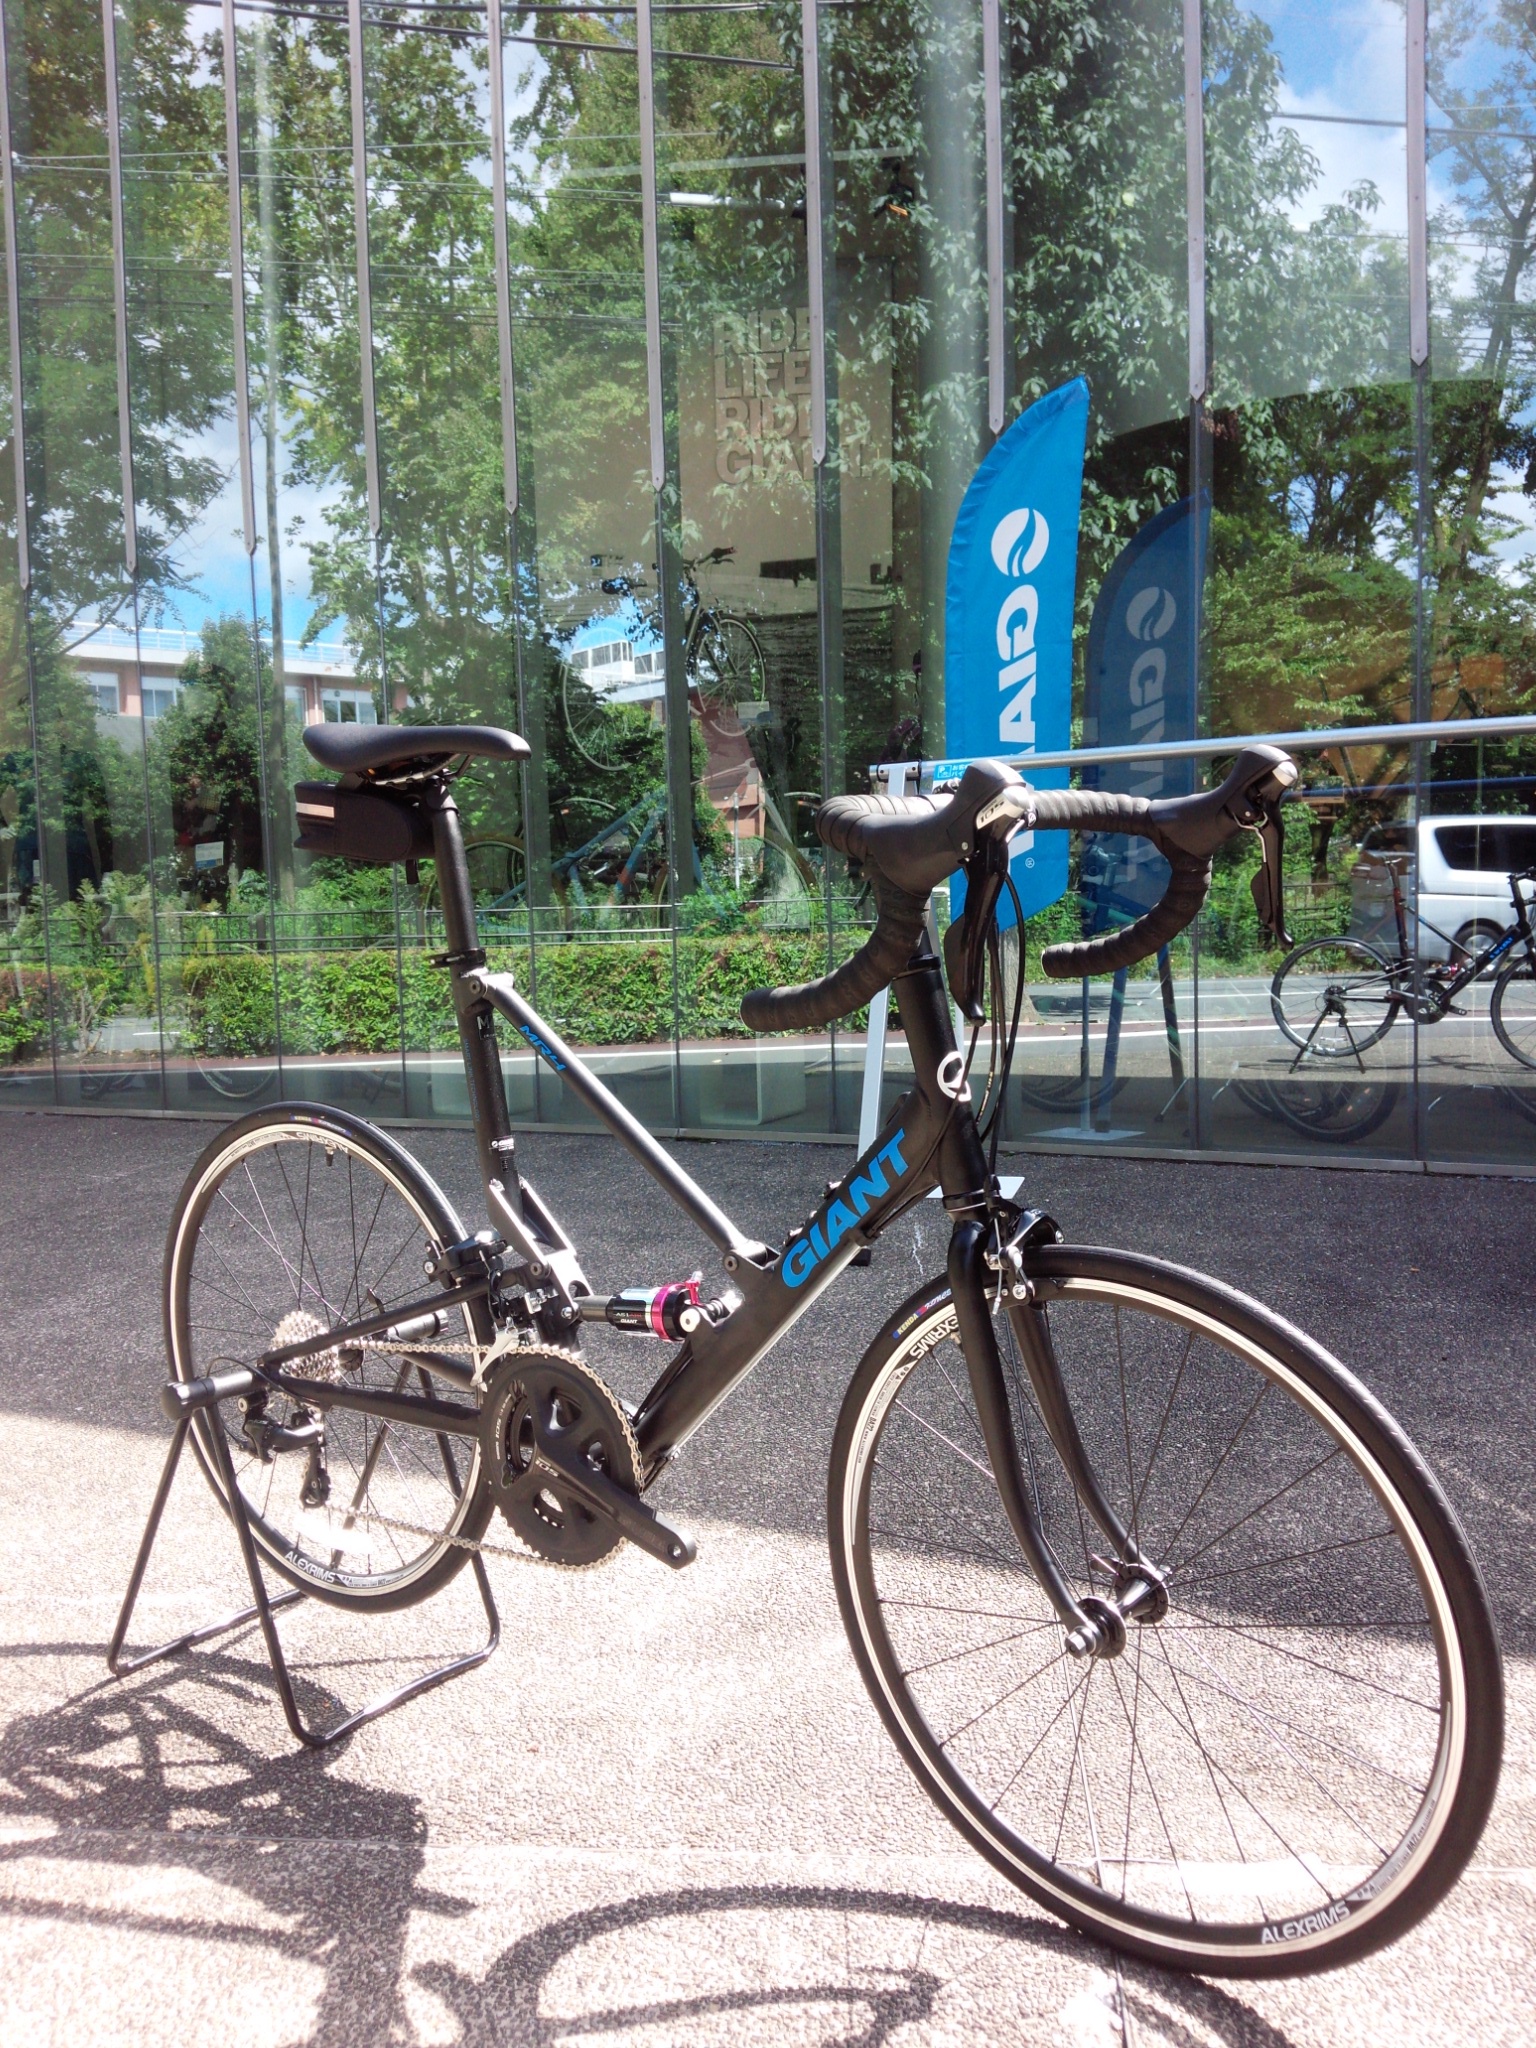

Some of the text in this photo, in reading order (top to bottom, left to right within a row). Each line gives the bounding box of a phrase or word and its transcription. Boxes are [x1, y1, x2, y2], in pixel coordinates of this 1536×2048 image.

[781, 1127, 909, 1288] GIANT
[896, 1312, 919, 1336] KENDA
[284, 1550, 337, 1584] ALEXRIMS
[1260, 1900, 1351, 1945] ALEXRIMS
